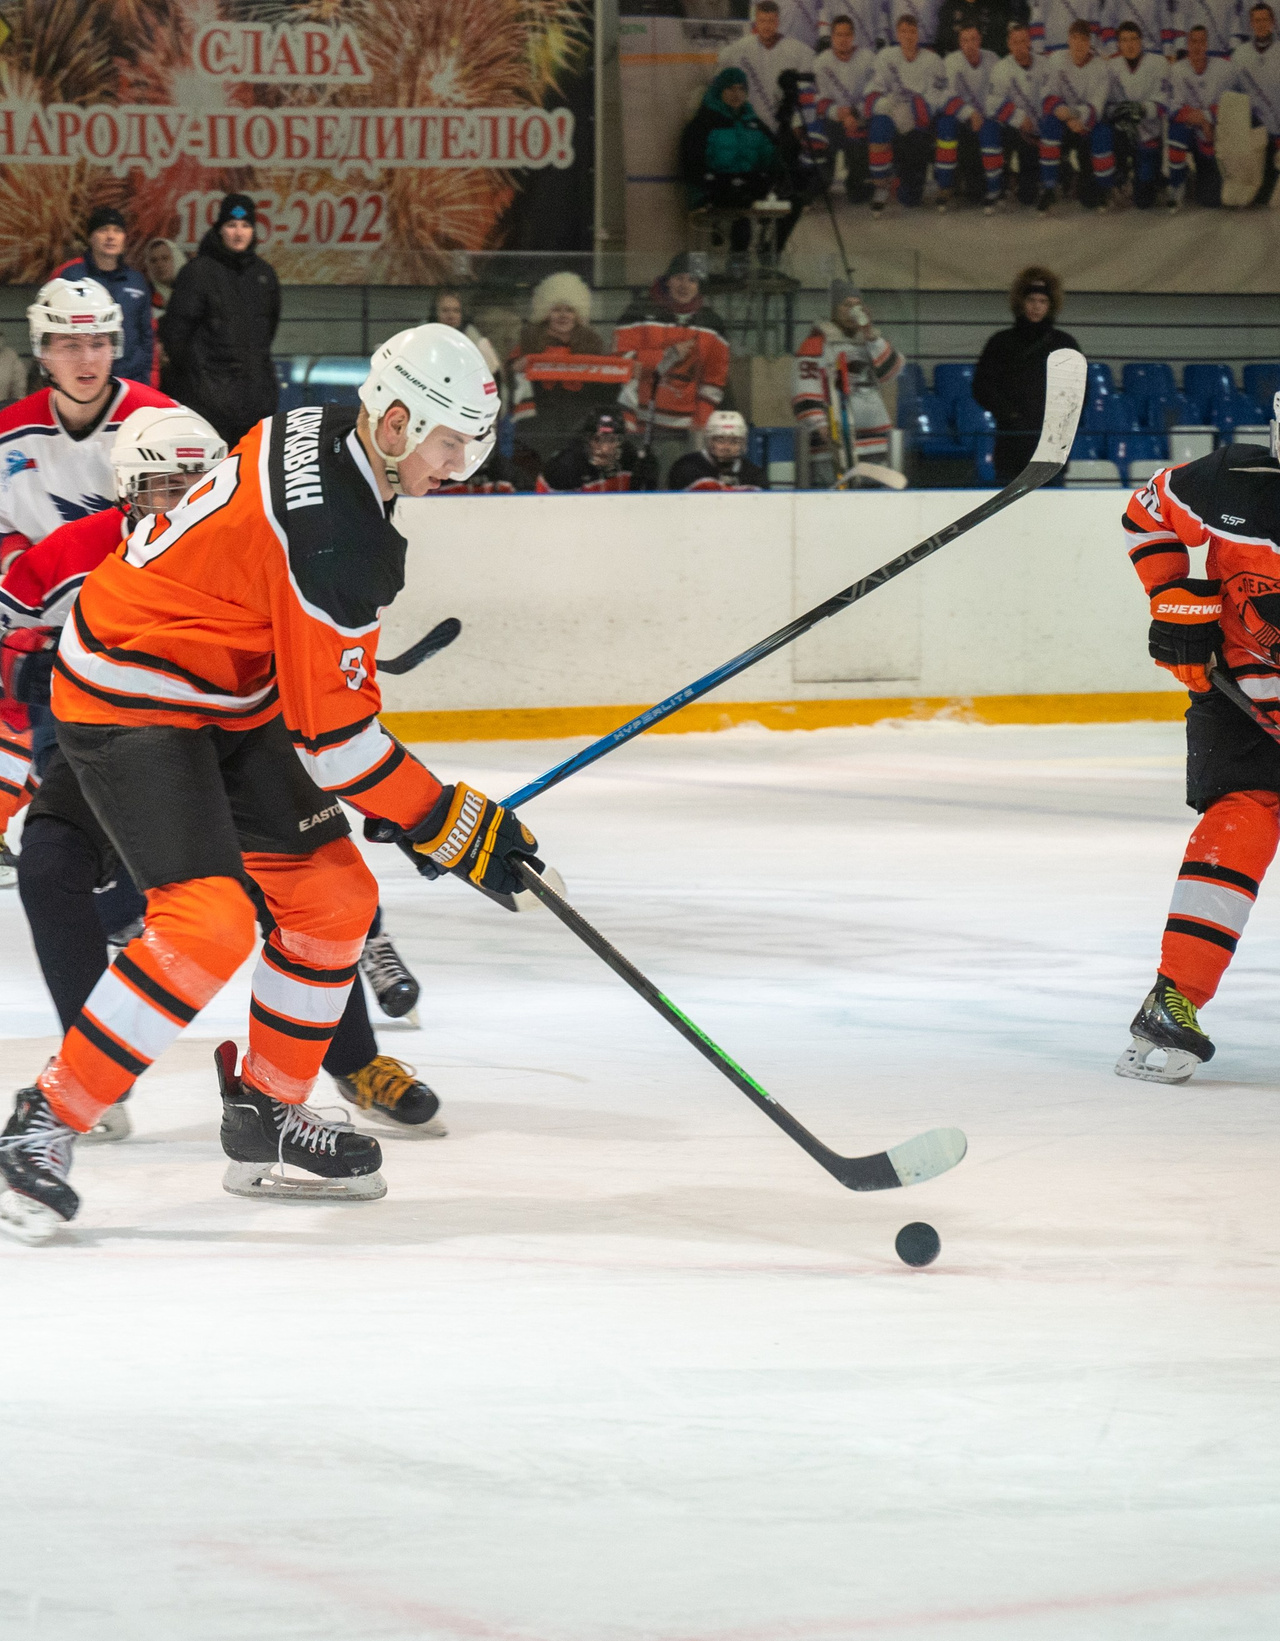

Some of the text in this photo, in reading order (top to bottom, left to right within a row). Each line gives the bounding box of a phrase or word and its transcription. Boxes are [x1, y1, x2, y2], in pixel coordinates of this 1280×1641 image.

[199, 30, 366, 78] СЛАВА
[184, 195, 384, 244] 15-2022
[283, 406, 324, 511] КАРКАВИН
[834, 523, 964, 602] VAPOR
[1157, 603, 1223, 616] SHERWO
[339, 646, 368, 691] 9
[613, 688, 695, 741] HYPERLITE
[430, 789, 485, 864] ARRIOR
